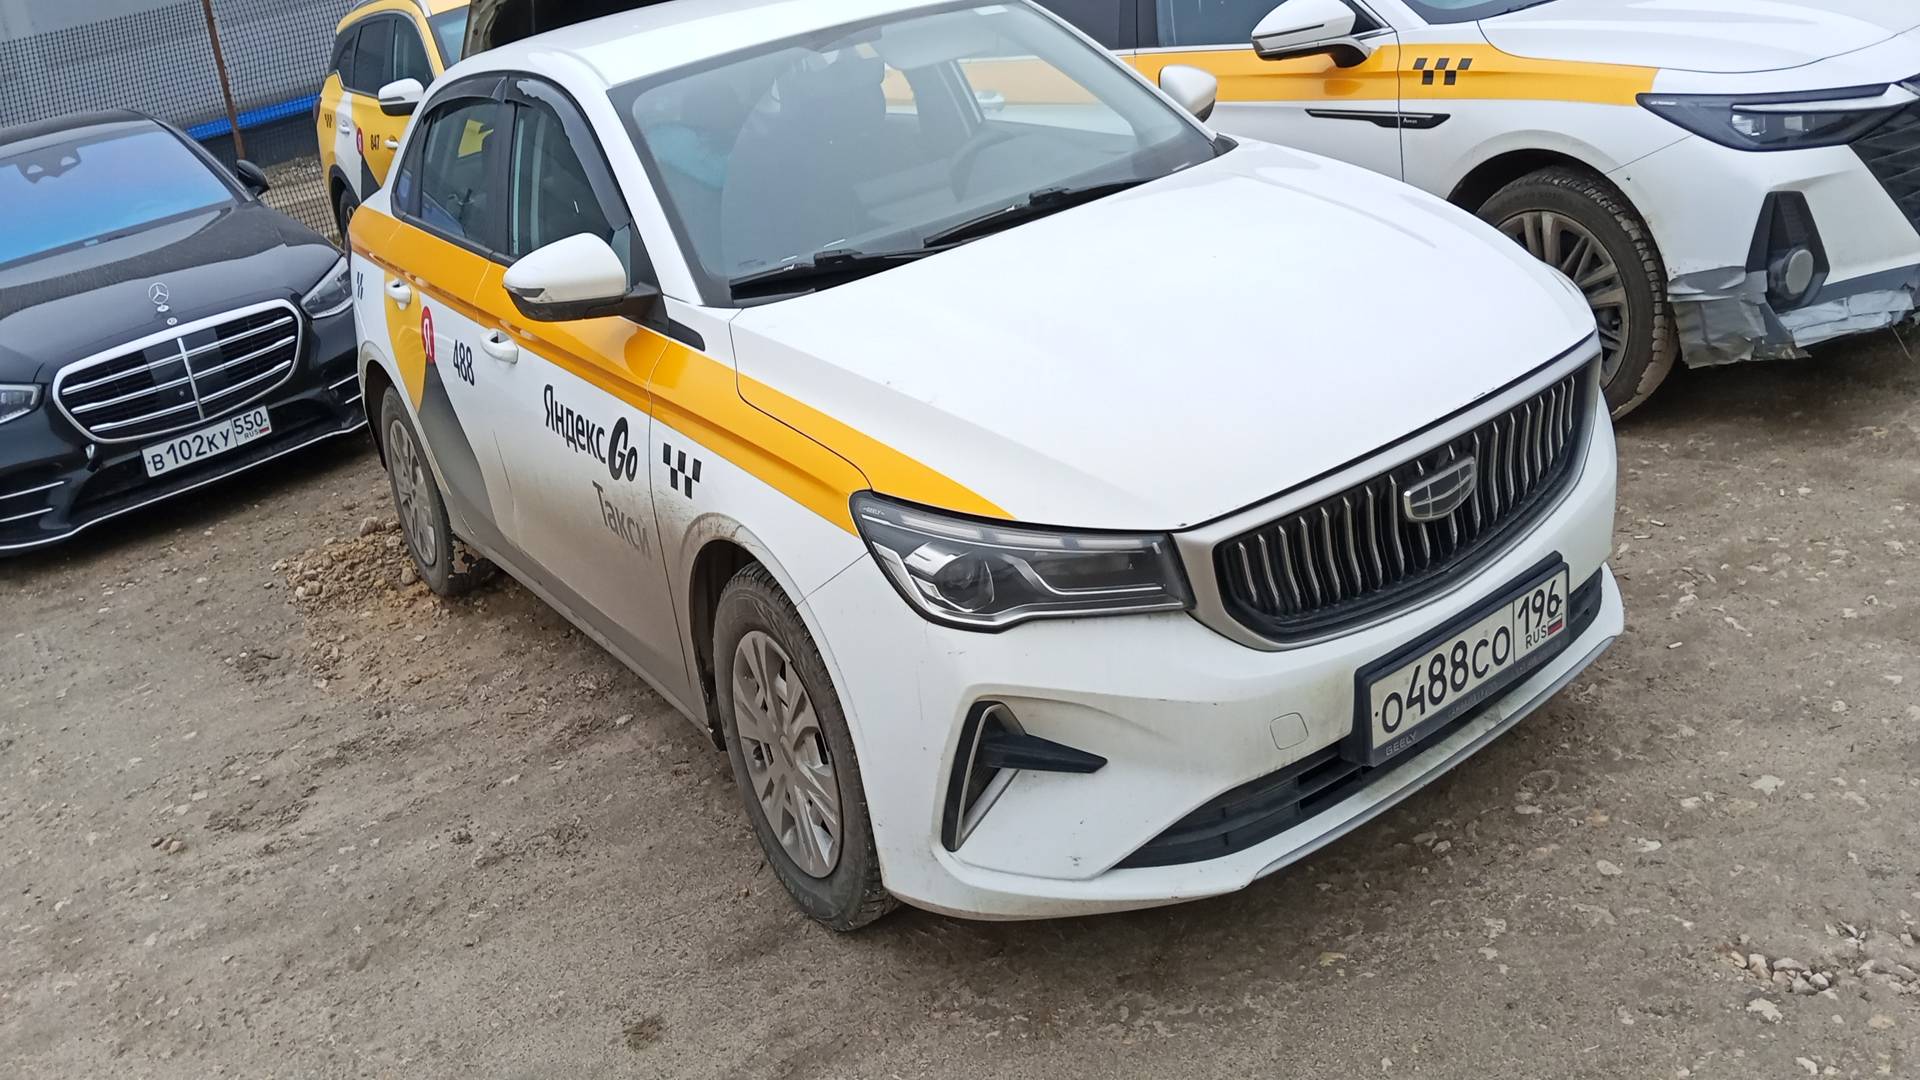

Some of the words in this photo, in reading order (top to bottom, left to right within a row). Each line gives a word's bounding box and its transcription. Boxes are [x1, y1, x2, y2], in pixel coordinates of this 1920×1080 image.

[453, 339, 475, 386] 488
[233, 410, 263, 435] 550
[543, 384, 606, 464] Яндекс
[608, 417, 638, 482] Go
[592, 480, 652, 556] Такси
[1517, 579, 1560, 635] 196
[1525, 624, 1547, 649] RUS
